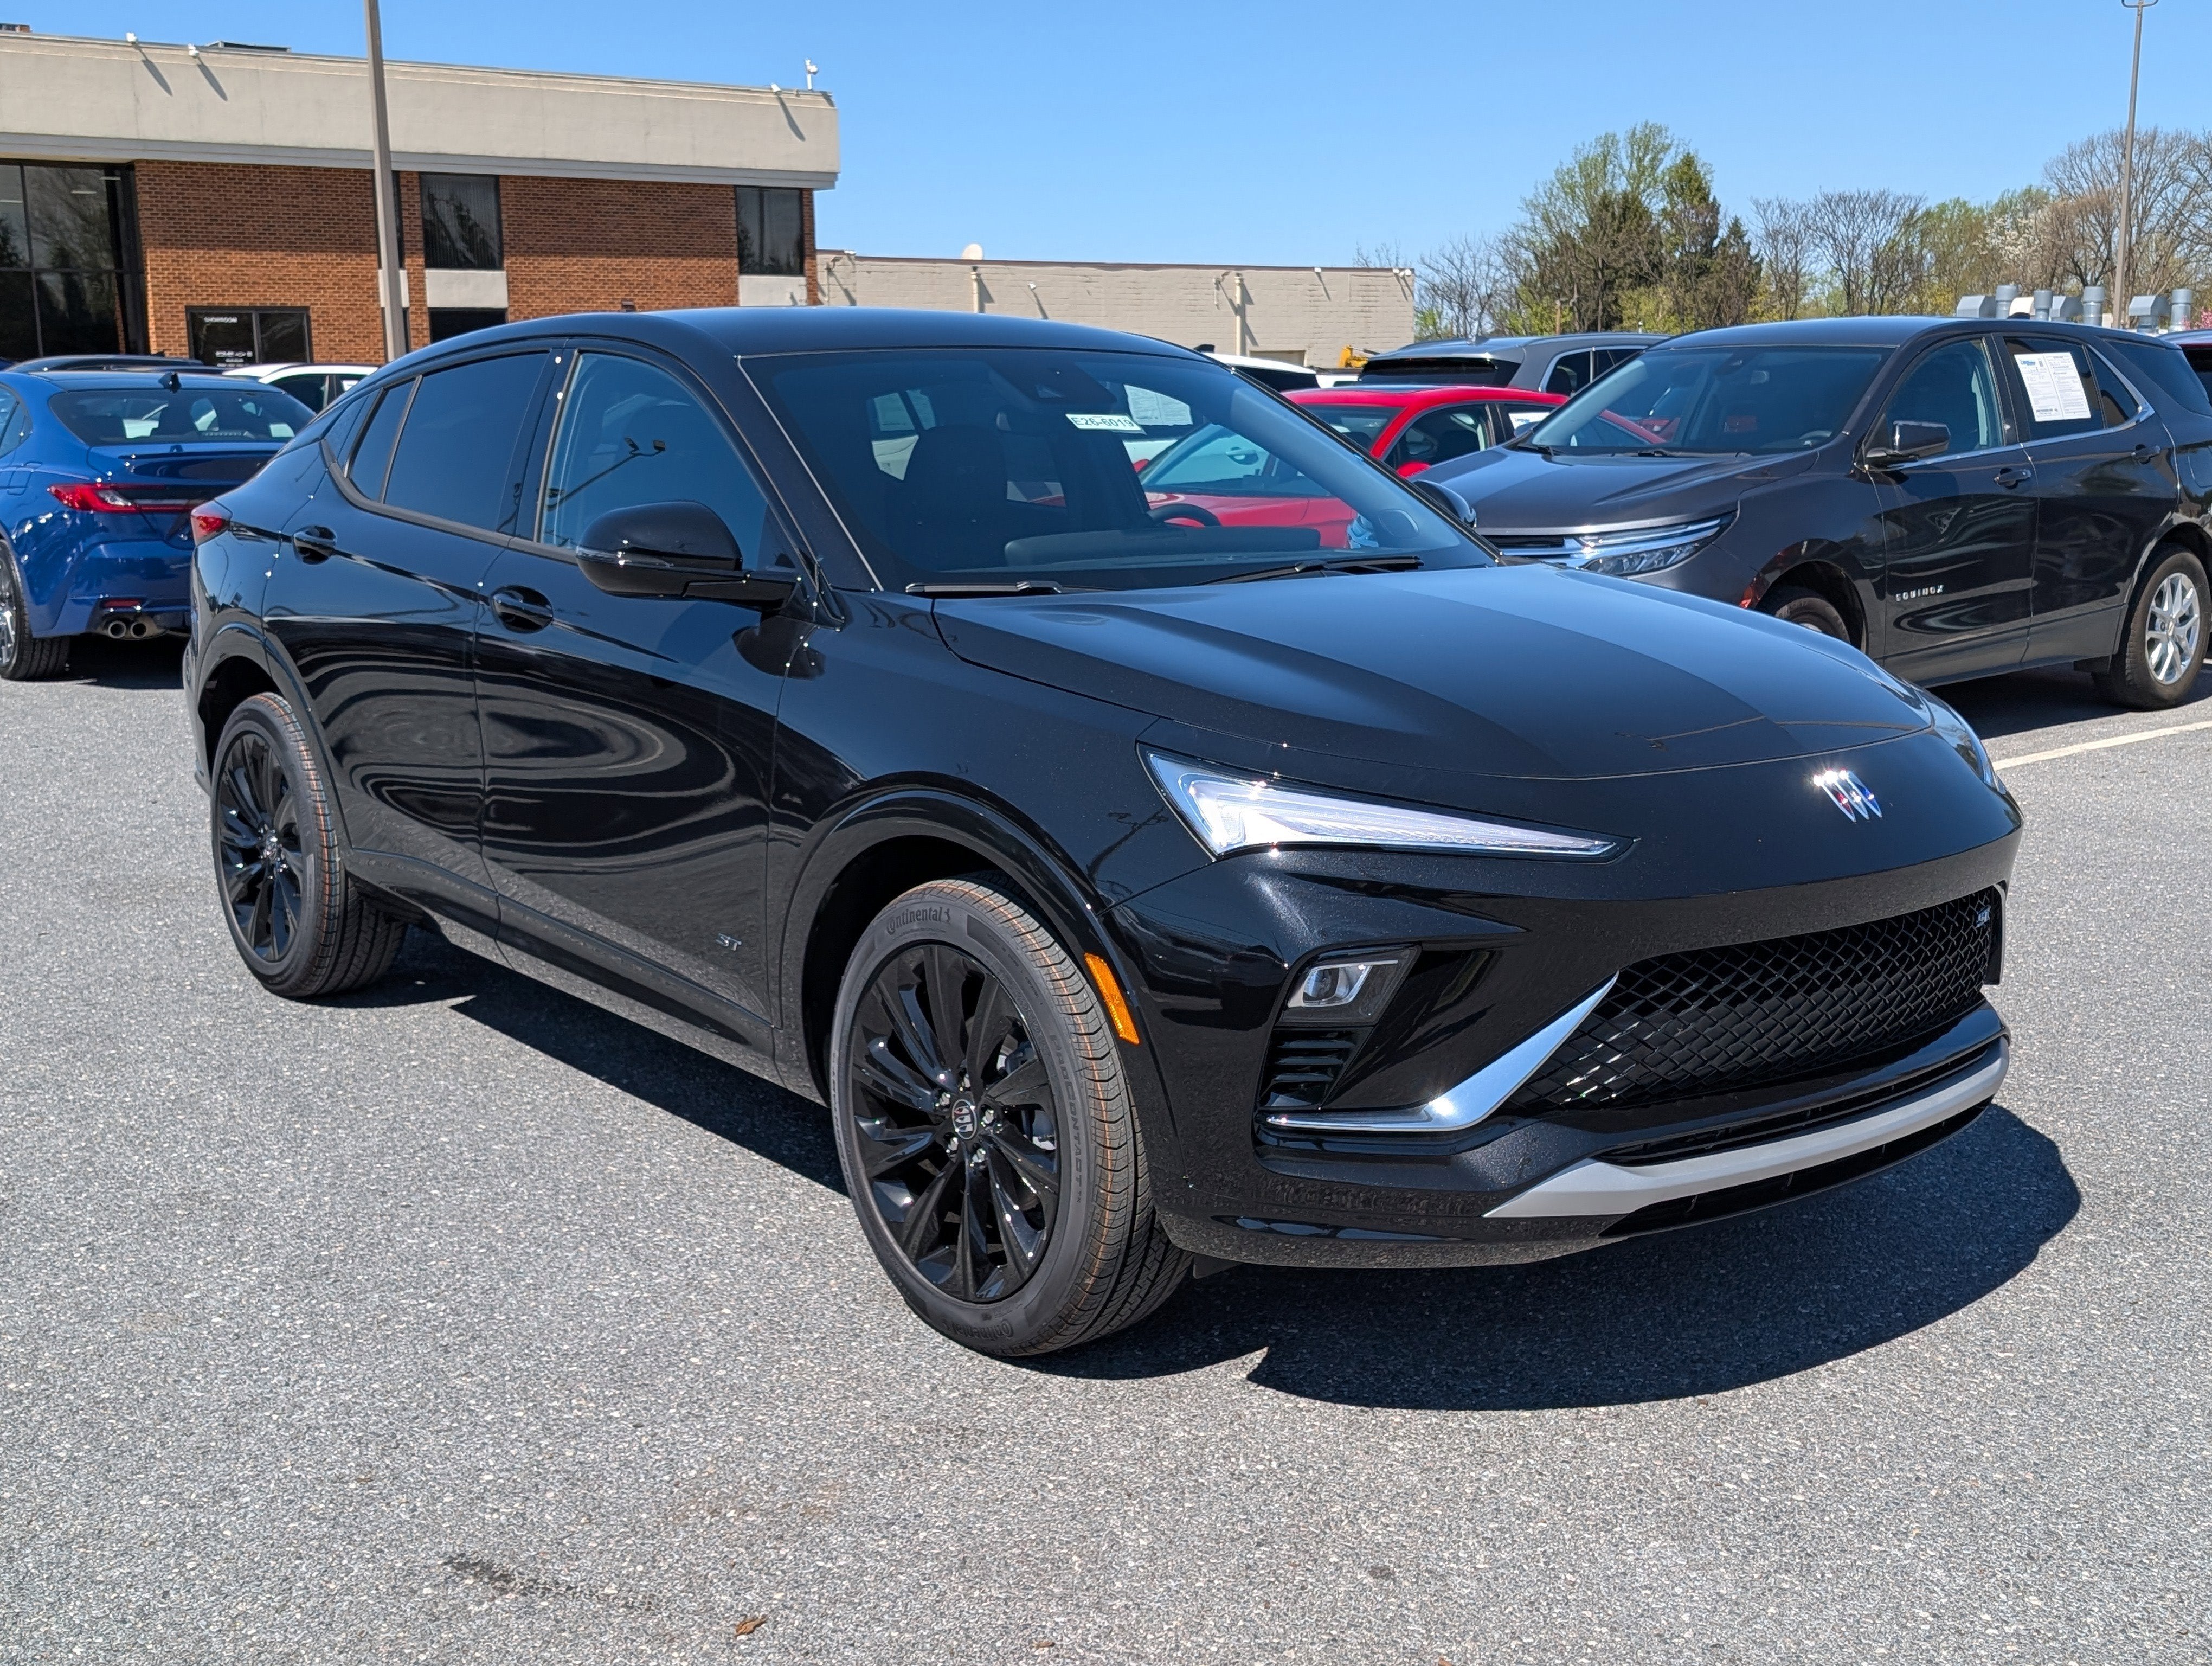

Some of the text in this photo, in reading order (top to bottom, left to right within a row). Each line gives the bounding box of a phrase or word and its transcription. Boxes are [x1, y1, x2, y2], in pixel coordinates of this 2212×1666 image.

[1070, 416, 1135, 427] E26-6019
[1895, 585, 1944, 601] EQUINOX
[886, 906, 943, 935] Continental
